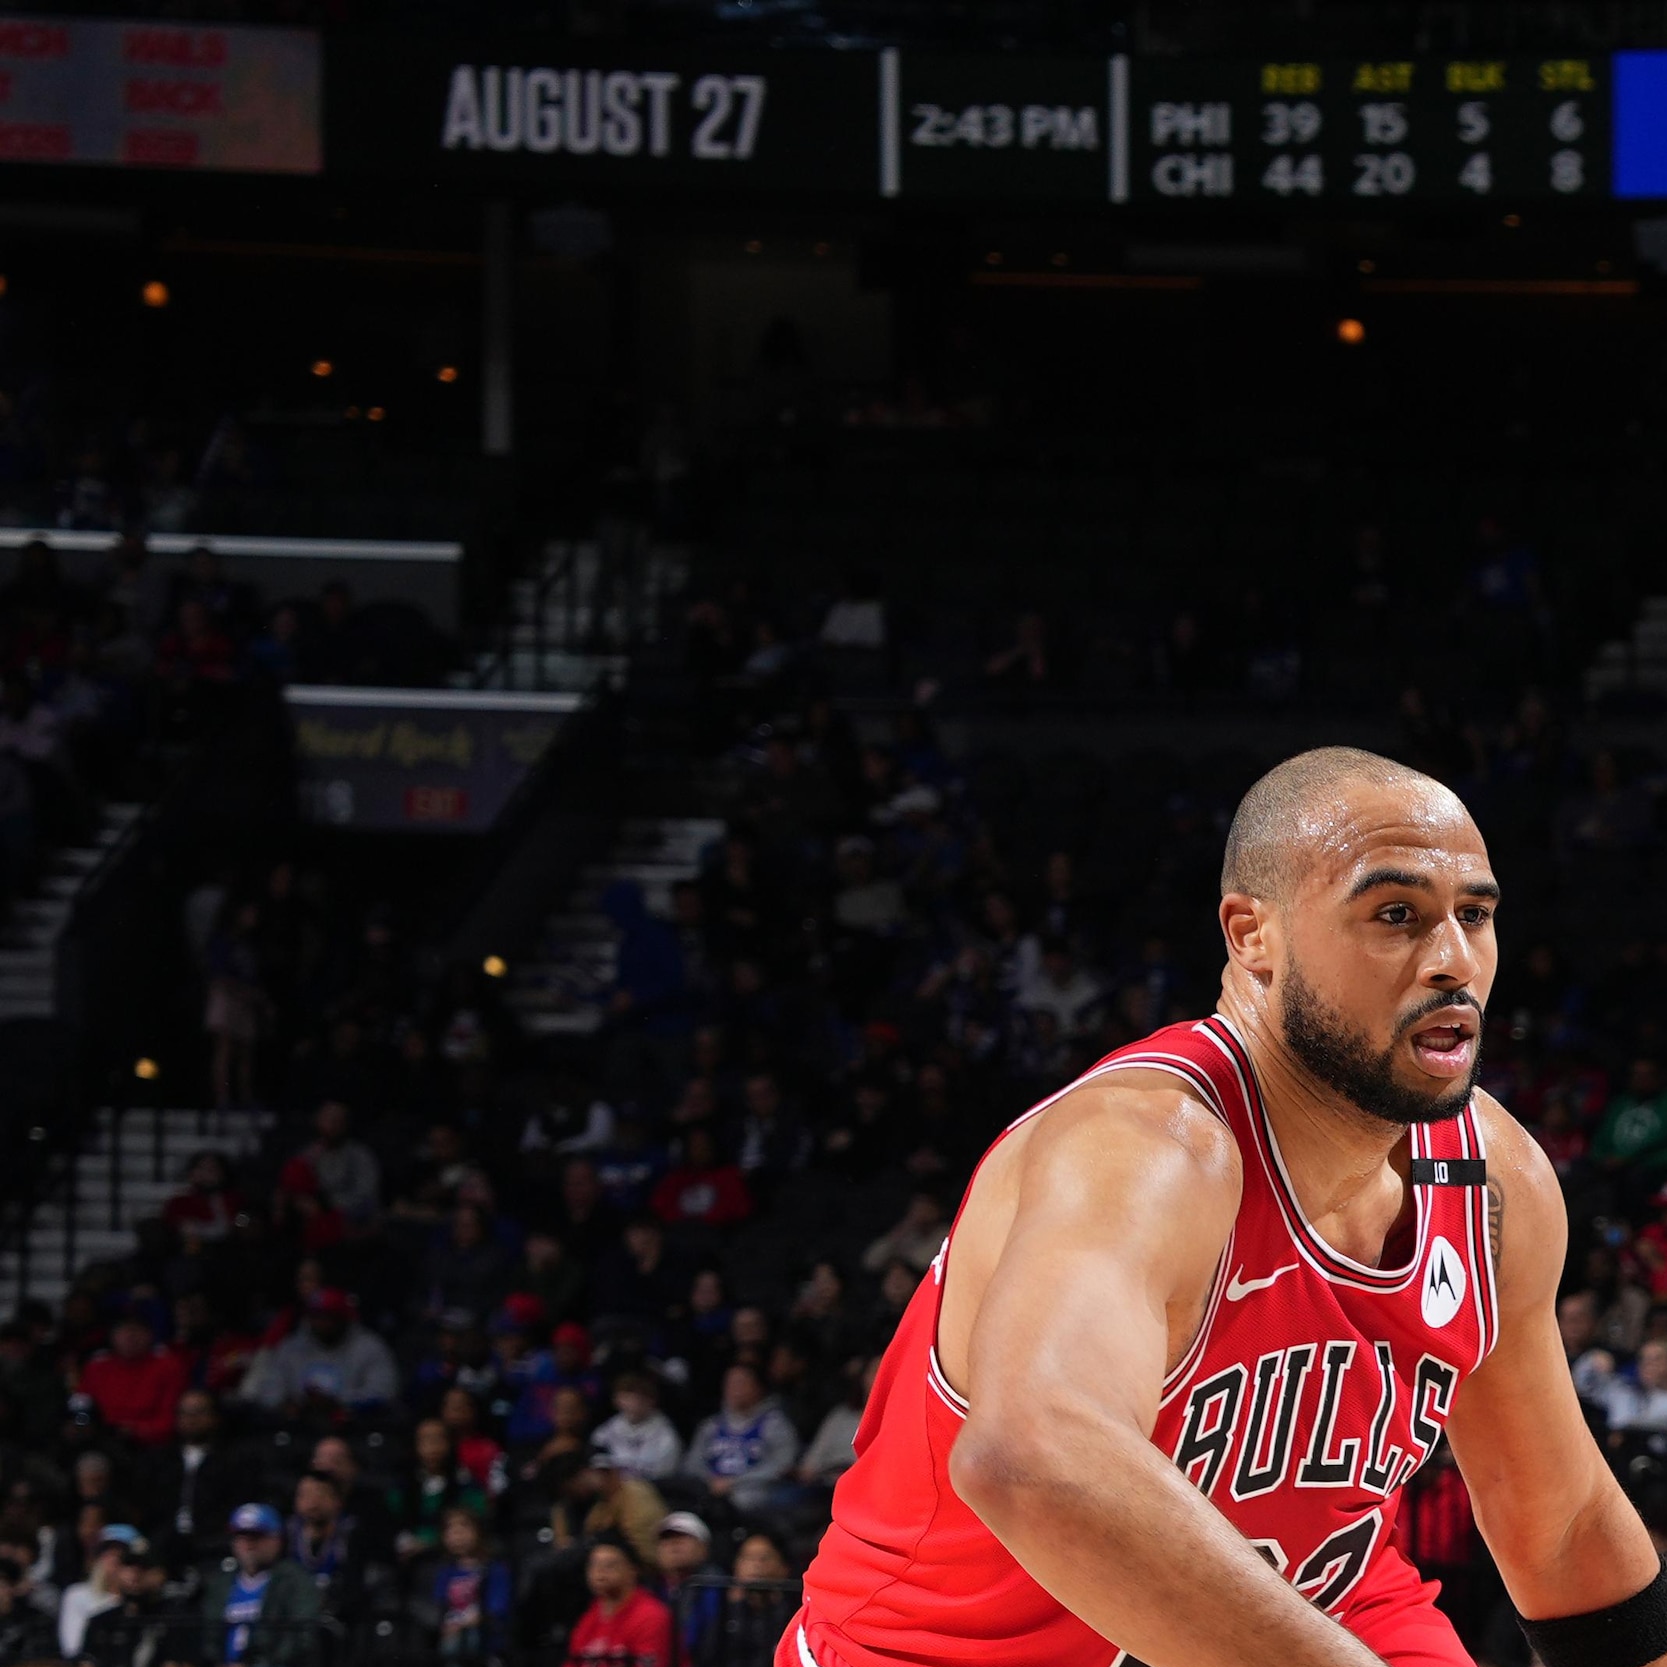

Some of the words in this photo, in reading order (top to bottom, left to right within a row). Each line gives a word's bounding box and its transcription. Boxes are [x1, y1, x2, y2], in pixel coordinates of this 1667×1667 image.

[1261, 62, 1321, 94] REB
[1353, 62, 1413, 93] AST
[1446, 62, 1504, 92] BLK
[1539, 60, 1594, 91] STL
[443, 65, 680, 157] AUGUST
[692, 74, 766, 159] 27
[911, 104, 1014, 147] 2:43
[1021, 105, 1098, 149] PM
[1152, 102, 1230, 145] PHI
[1263, 102, 1322, 145] 39
[1359, 102, 1408, 144] 15
[1458, 102, 1490, 143] 5
[1550, 101, 1583, 142] 6
[1152, 154, 1233, 195] CHI
[1263, 154, 1324, 195] 44
[1354, 153, 1415, 196] 20
[1459, 153, 1492, 193] 4
[1550, 151, 1584, 193] 8
[1434, 1161, 1449, 1185] 10
[1171, 1339, 1459, 1503] BULLS
